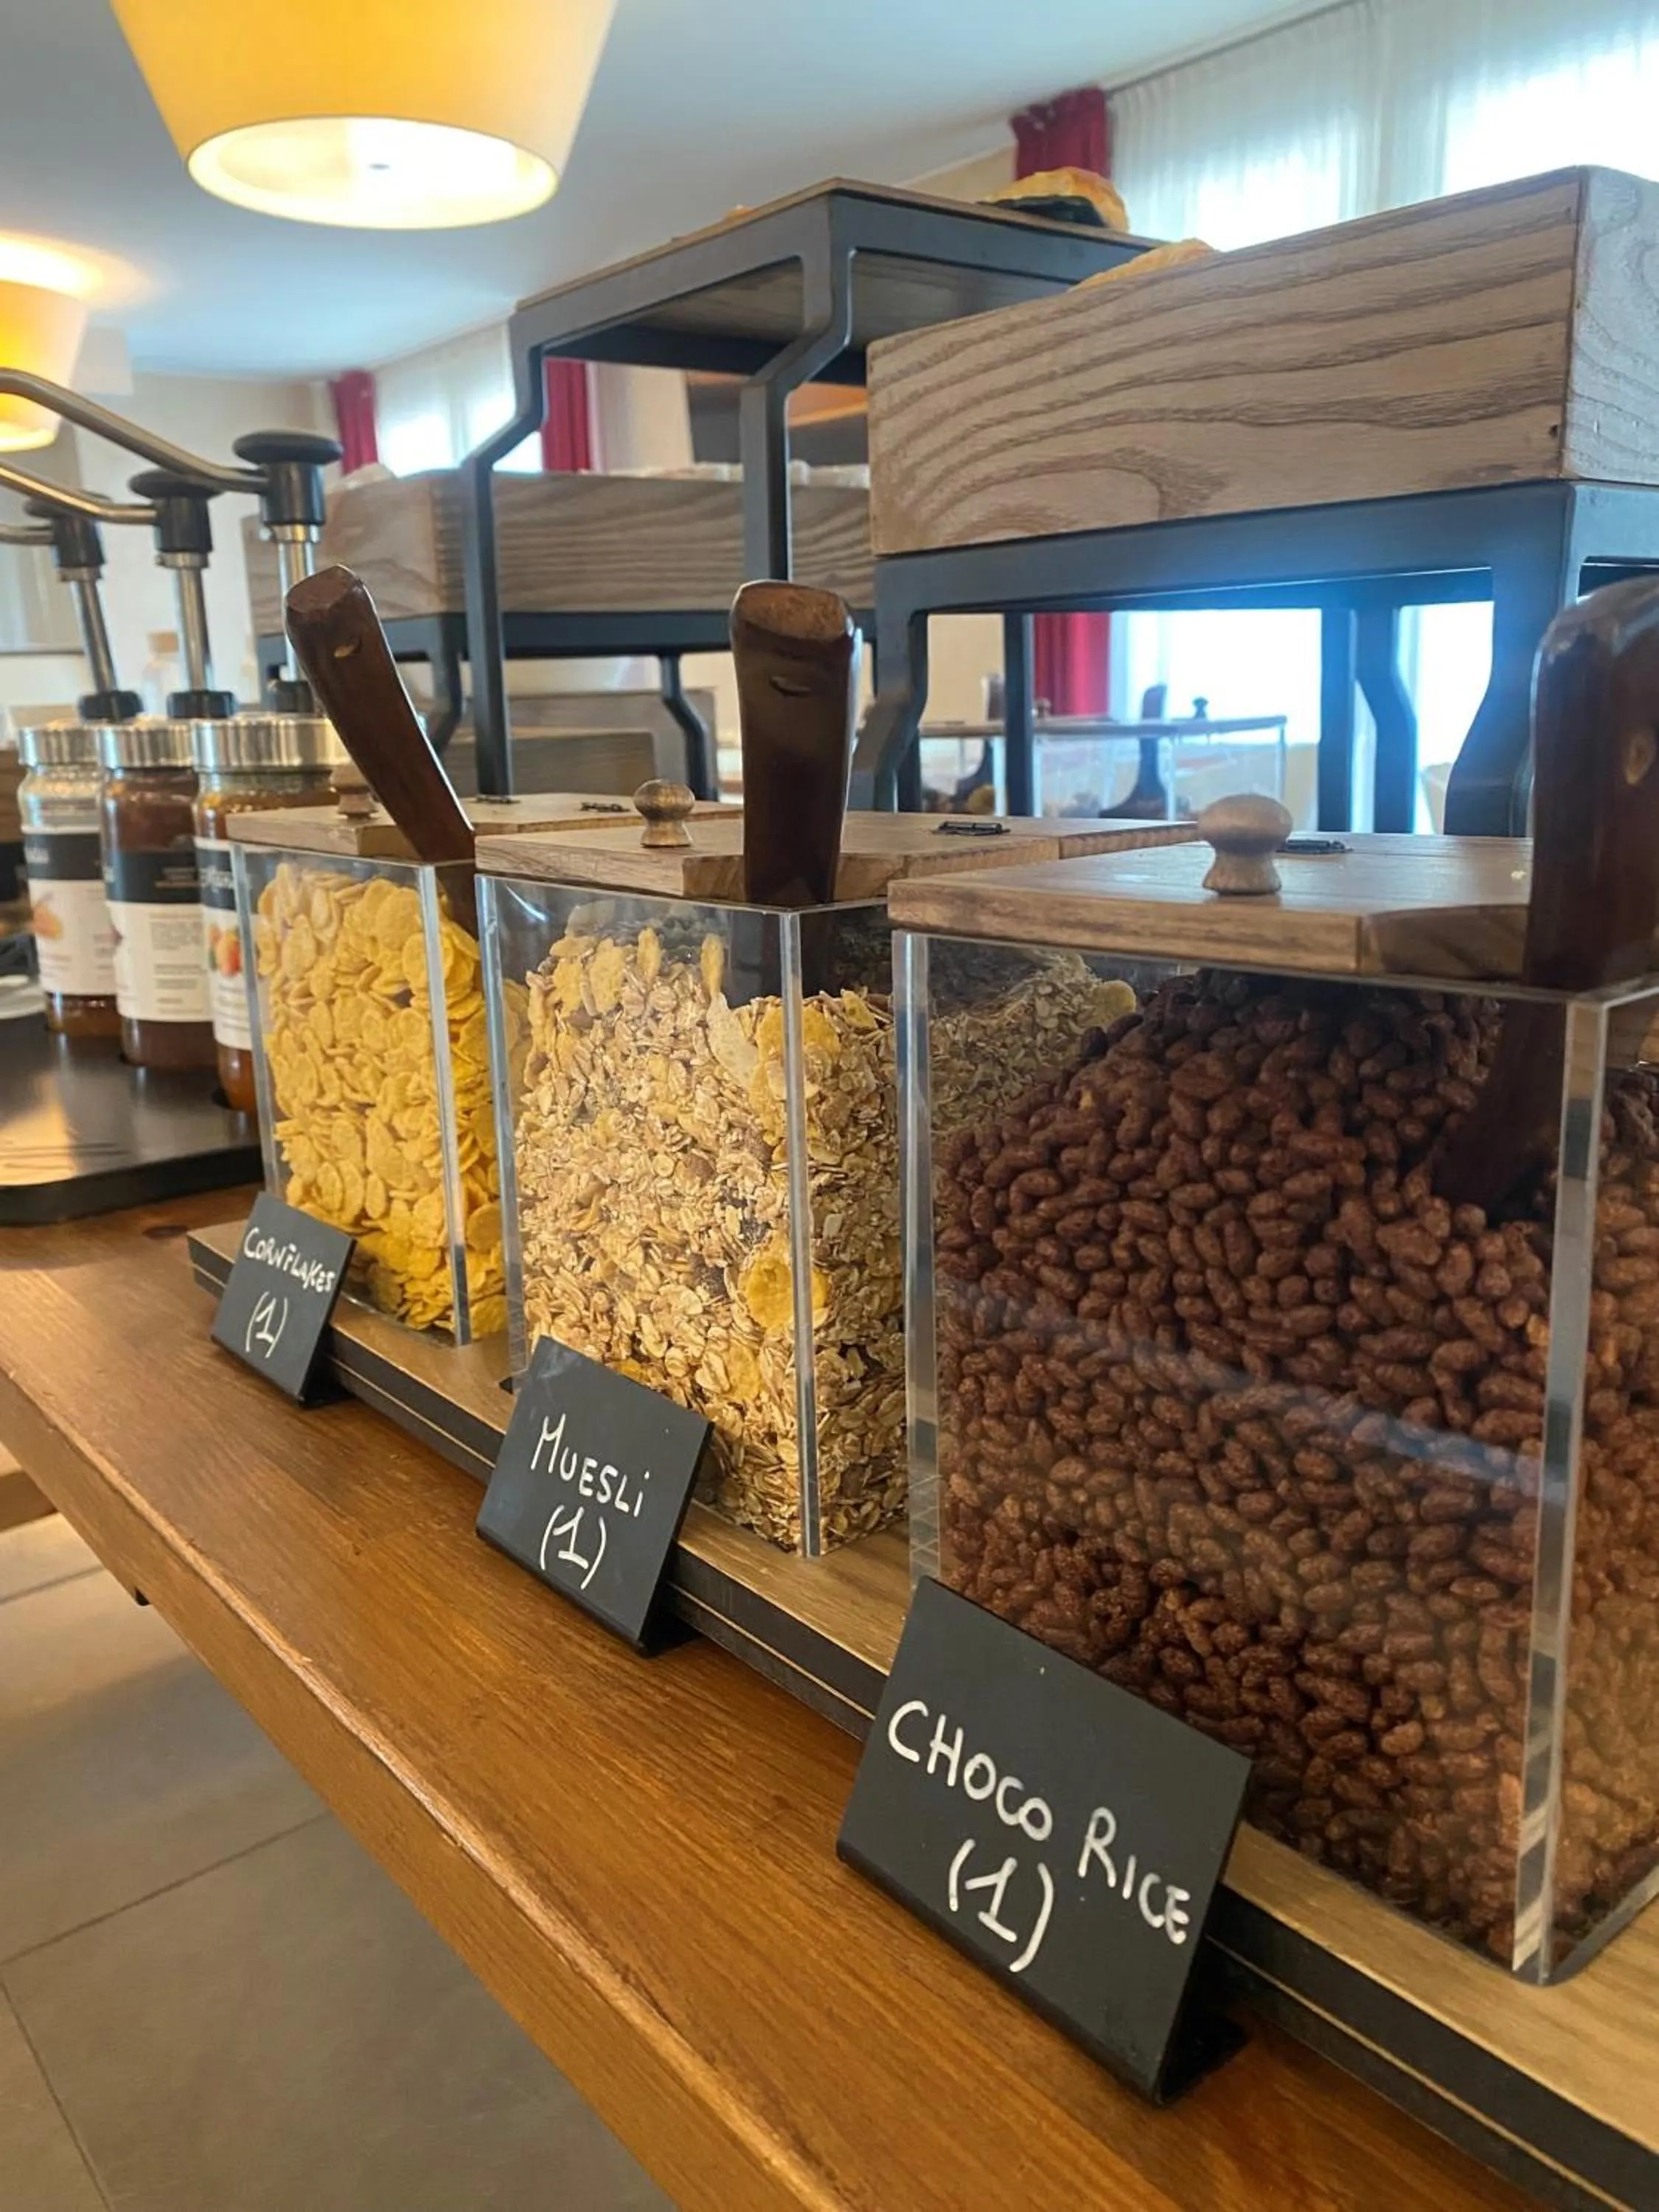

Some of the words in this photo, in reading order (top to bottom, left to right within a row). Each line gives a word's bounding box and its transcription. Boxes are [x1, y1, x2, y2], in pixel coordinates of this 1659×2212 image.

[245, 1291, 288, 1359] (1)
[539, 1504, 608, 1590] (1)
[887, 1700, 1054, 1841] CHOCO
[1077, 1806, 1191, 1945] RICE
[948, 1838, 1054, 1973] (1)
